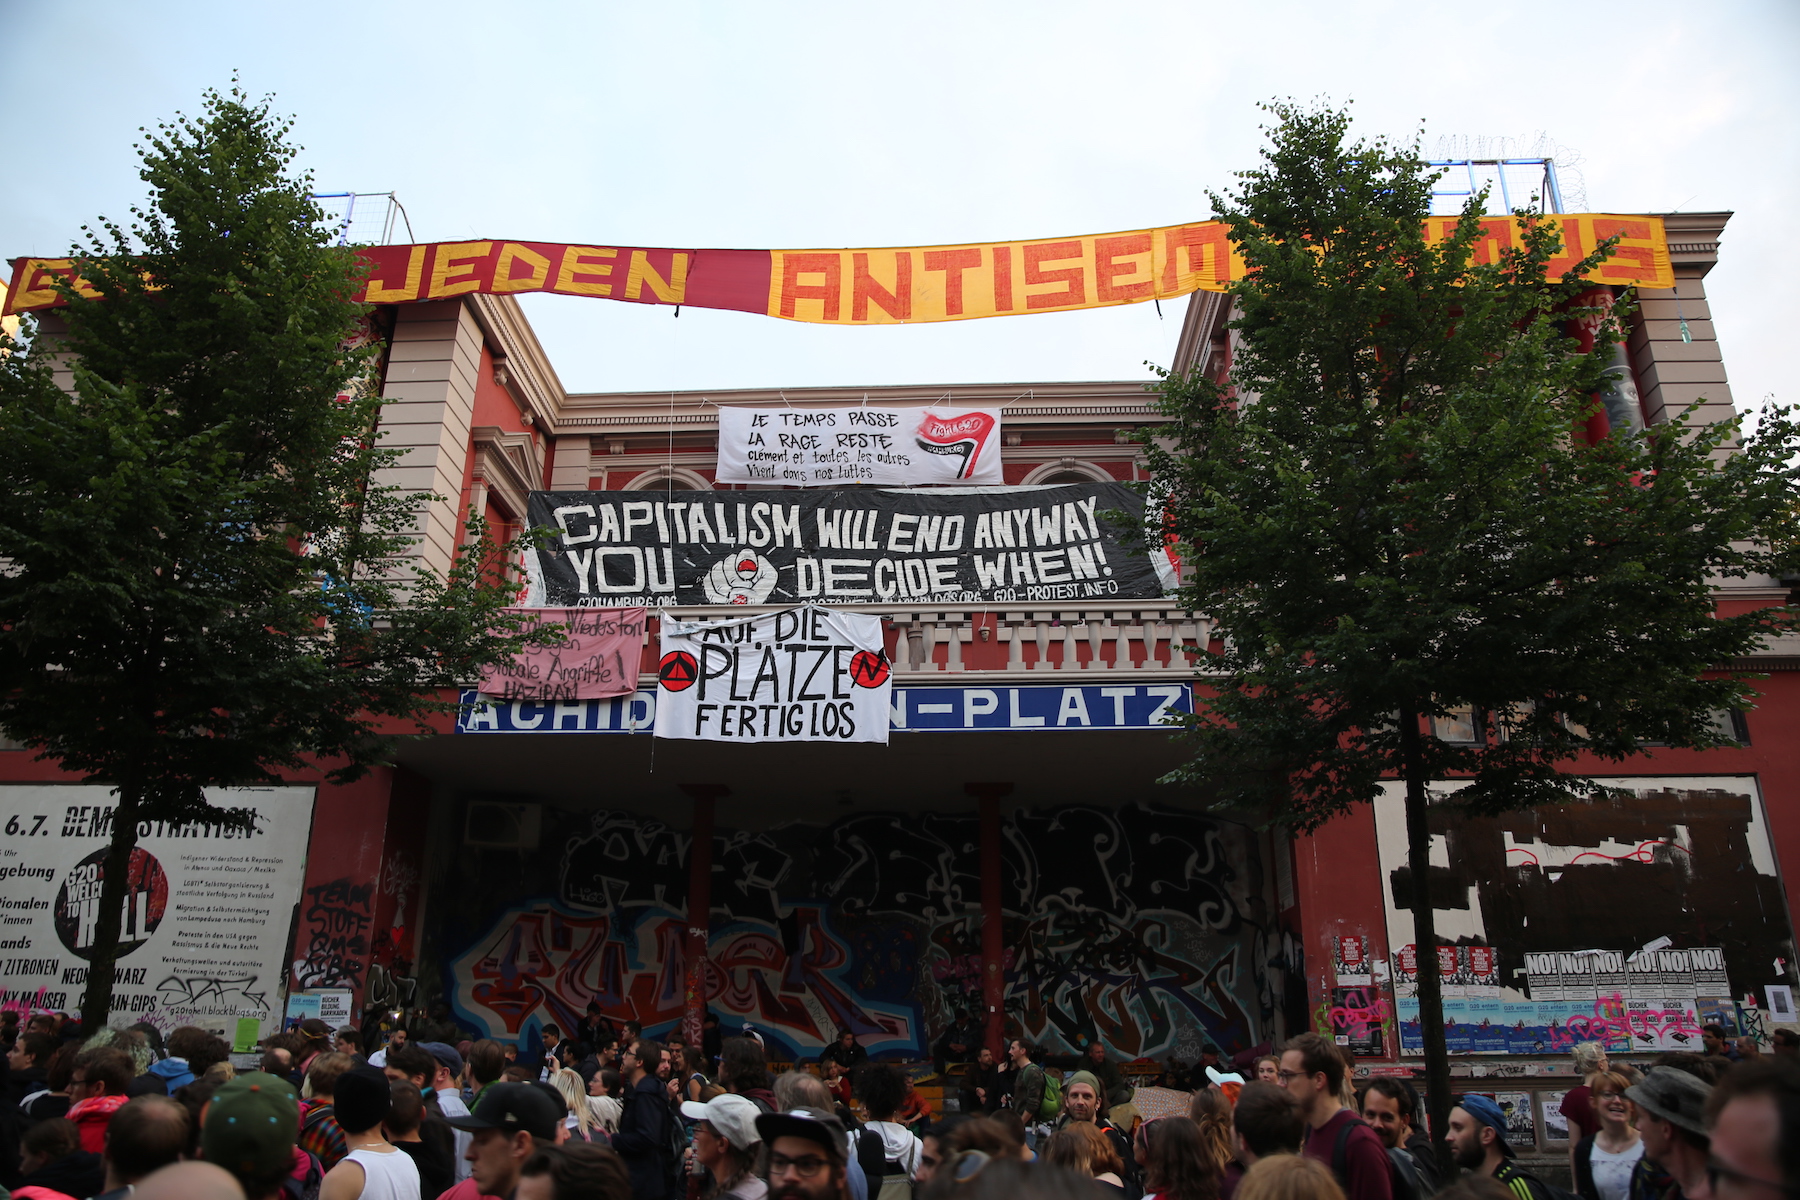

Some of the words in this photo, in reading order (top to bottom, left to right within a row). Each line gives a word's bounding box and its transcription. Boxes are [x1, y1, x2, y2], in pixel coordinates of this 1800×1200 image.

[366, 242, 687, 303] JEDEN
[780, 218, 1658, 321] ANTISEMMUS
[751, 413, 769, 428] LE
[778, 413, 836, 427] TEMPS
[848, 411, 899, 427] PASSE
[957, 419, 981, 432] G20
[747, 432, 766, 447] LA
[779, 434, 819, 449] RAGE
[837, 433, 893, 450] RESTE
[792, 451, 804, 465] et
[812, 449, 848, 463] toutes
[857, 449, 871, 463] les
[877, 453, 910, 465] autres
[783, 466, 807, 482] dans
[815, 464, 832, 480] nos
[553, 501, 802, 548] CAPITALISM
[817, 507, 879, 550] WILL
[888, 512, 965, 553] END
[973, 495, 1099, 549] ANYWAY
[567, 546, 675, 594] YOU
[796, 557, 962, 598] DECIDE
[973, 542, 1113, 590] WHEN!
[993, 580, 1118, 601] G20-PROTEST.INFO
[702, 622, 757, 643] AUF
[775, 609, 829, 642] DIE
[547, 654, 612, 688] Angriffe
[697, 642, 854, 703] PLÄTZE
[5, 815, 48, 837] 6.7.
[4, 849, 17, 857] Uhr
[66, 863, 98, 887] G20
[67, 879, 104, 902] WELC
[307, 879, 374, 913] TEAM
[66, 902, 80, 919] TO
[176, 904, 205, 913] Migration
[75, 891, 153, 949] HLL
[306, 905, 372, 935] STOFF
[238, 934, 257, 942] gegen
[4, 958, 59, 976] ZITRONEN
[1526, 953, 1558, 975] NO!
[1560, 953, 1592, 975] NO!
[1592, 952, 1625, 973] NO!
[1658, 951, 1691, 973] NO!
[1691, 949, 1724, 971] NO!
[19, 991, 66, 1010] MAUSER
